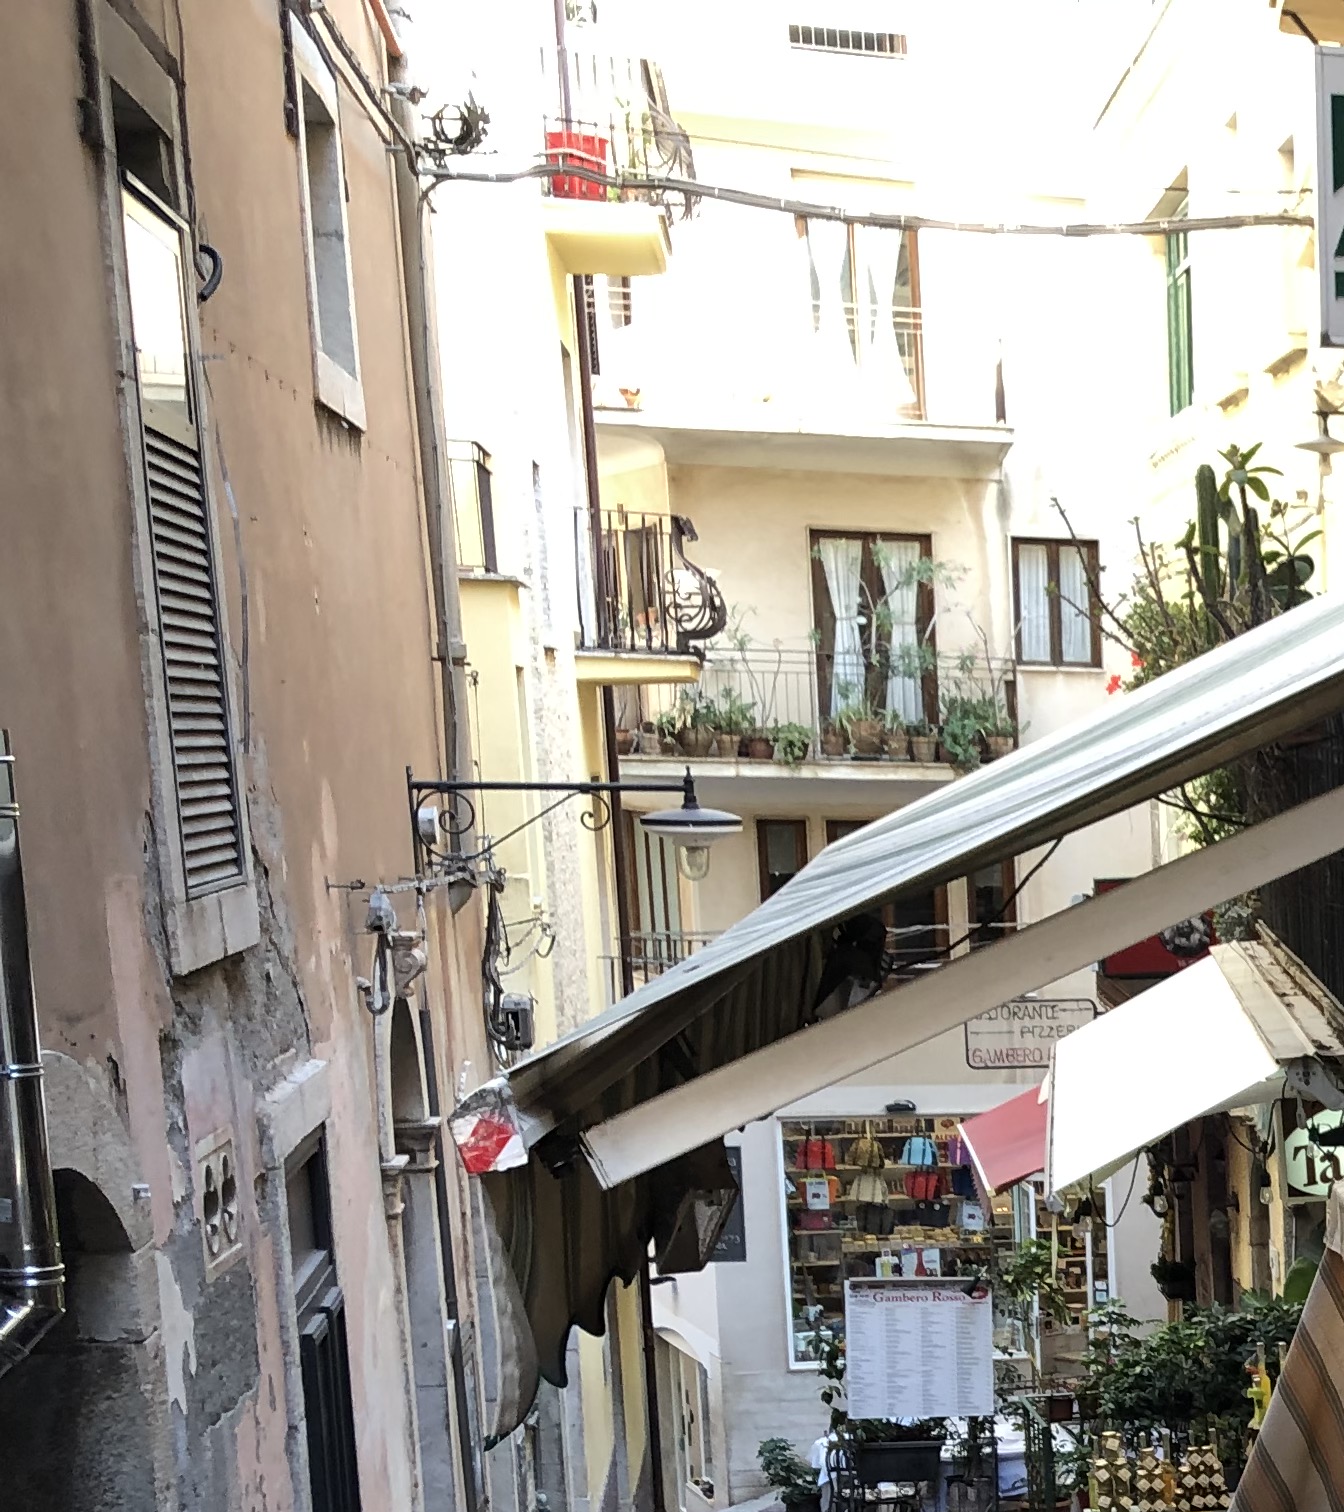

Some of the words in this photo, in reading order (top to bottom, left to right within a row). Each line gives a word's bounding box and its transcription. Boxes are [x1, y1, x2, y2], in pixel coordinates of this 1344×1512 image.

[972, 1048, 1043, 1066] GAMBERO
[873, 1291, 929, 1303] Gambero
[932, 1291, 966, 1303] Rosso
